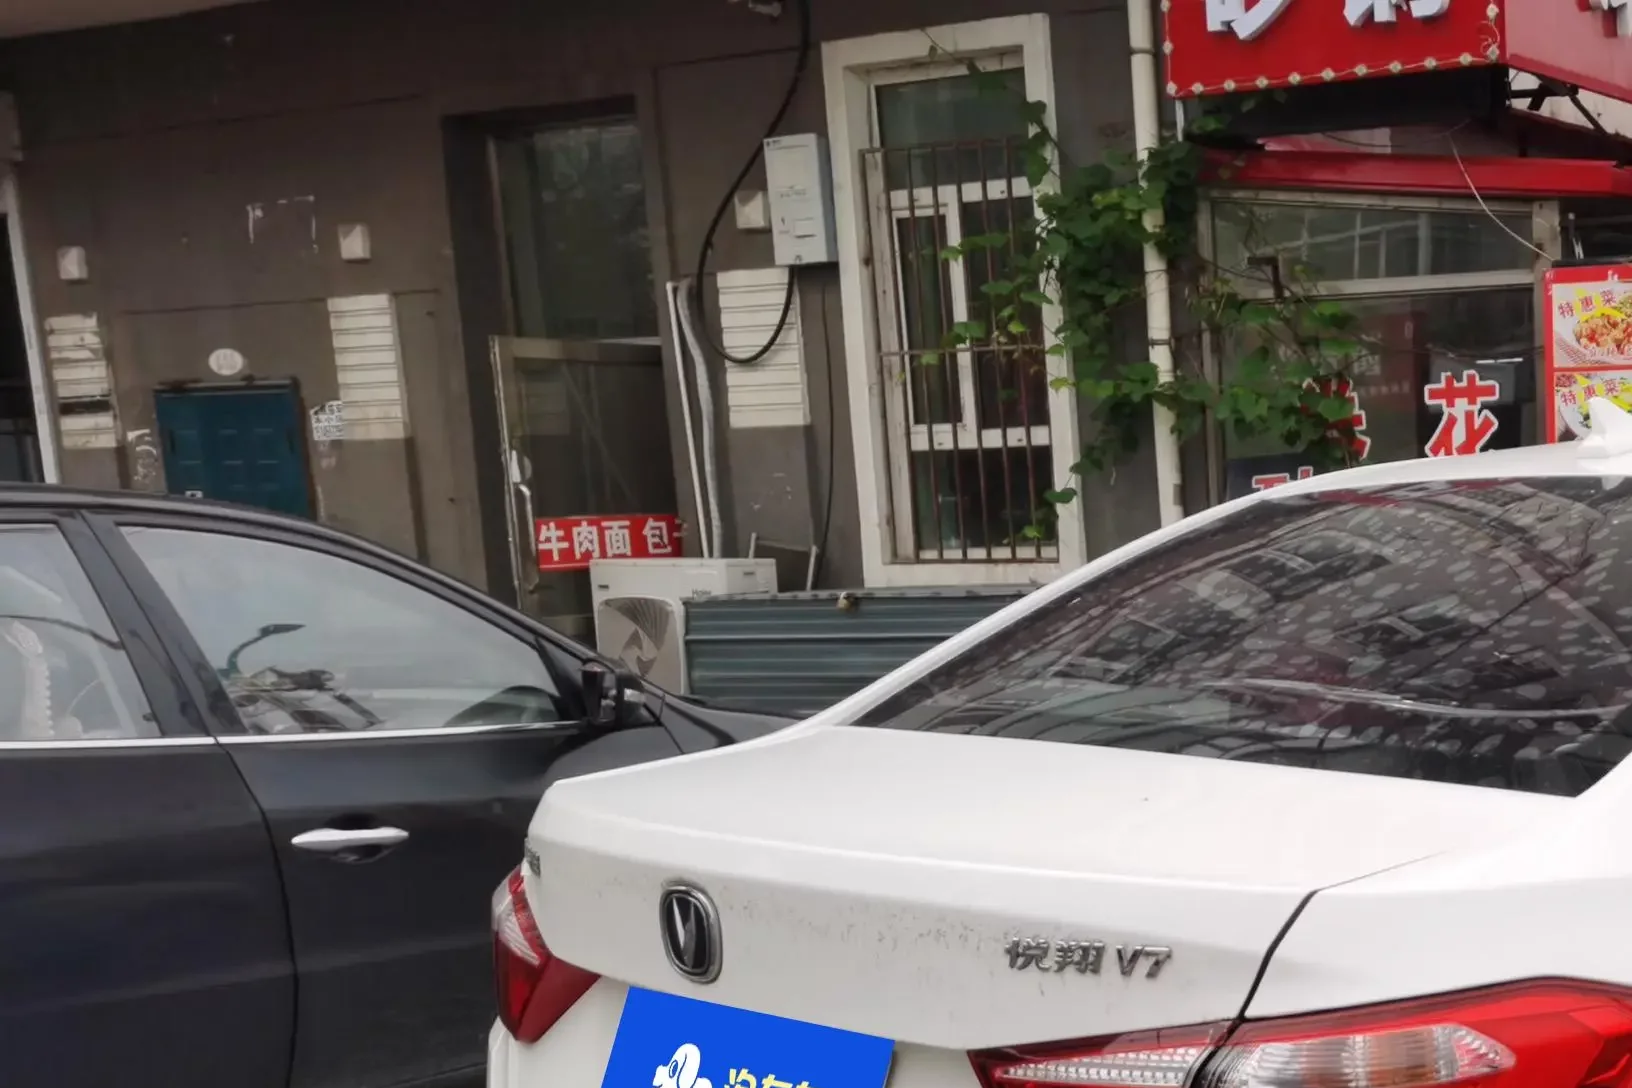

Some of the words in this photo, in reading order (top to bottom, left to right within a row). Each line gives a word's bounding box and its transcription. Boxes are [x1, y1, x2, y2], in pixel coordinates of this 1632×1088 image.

[1424, 369, 1500, 457] 花
[538, 520, 631, 561] 牛肉面
[1004, 938, 1106, 975] 悦翔
[1115, 945, 1172, 979] V7
